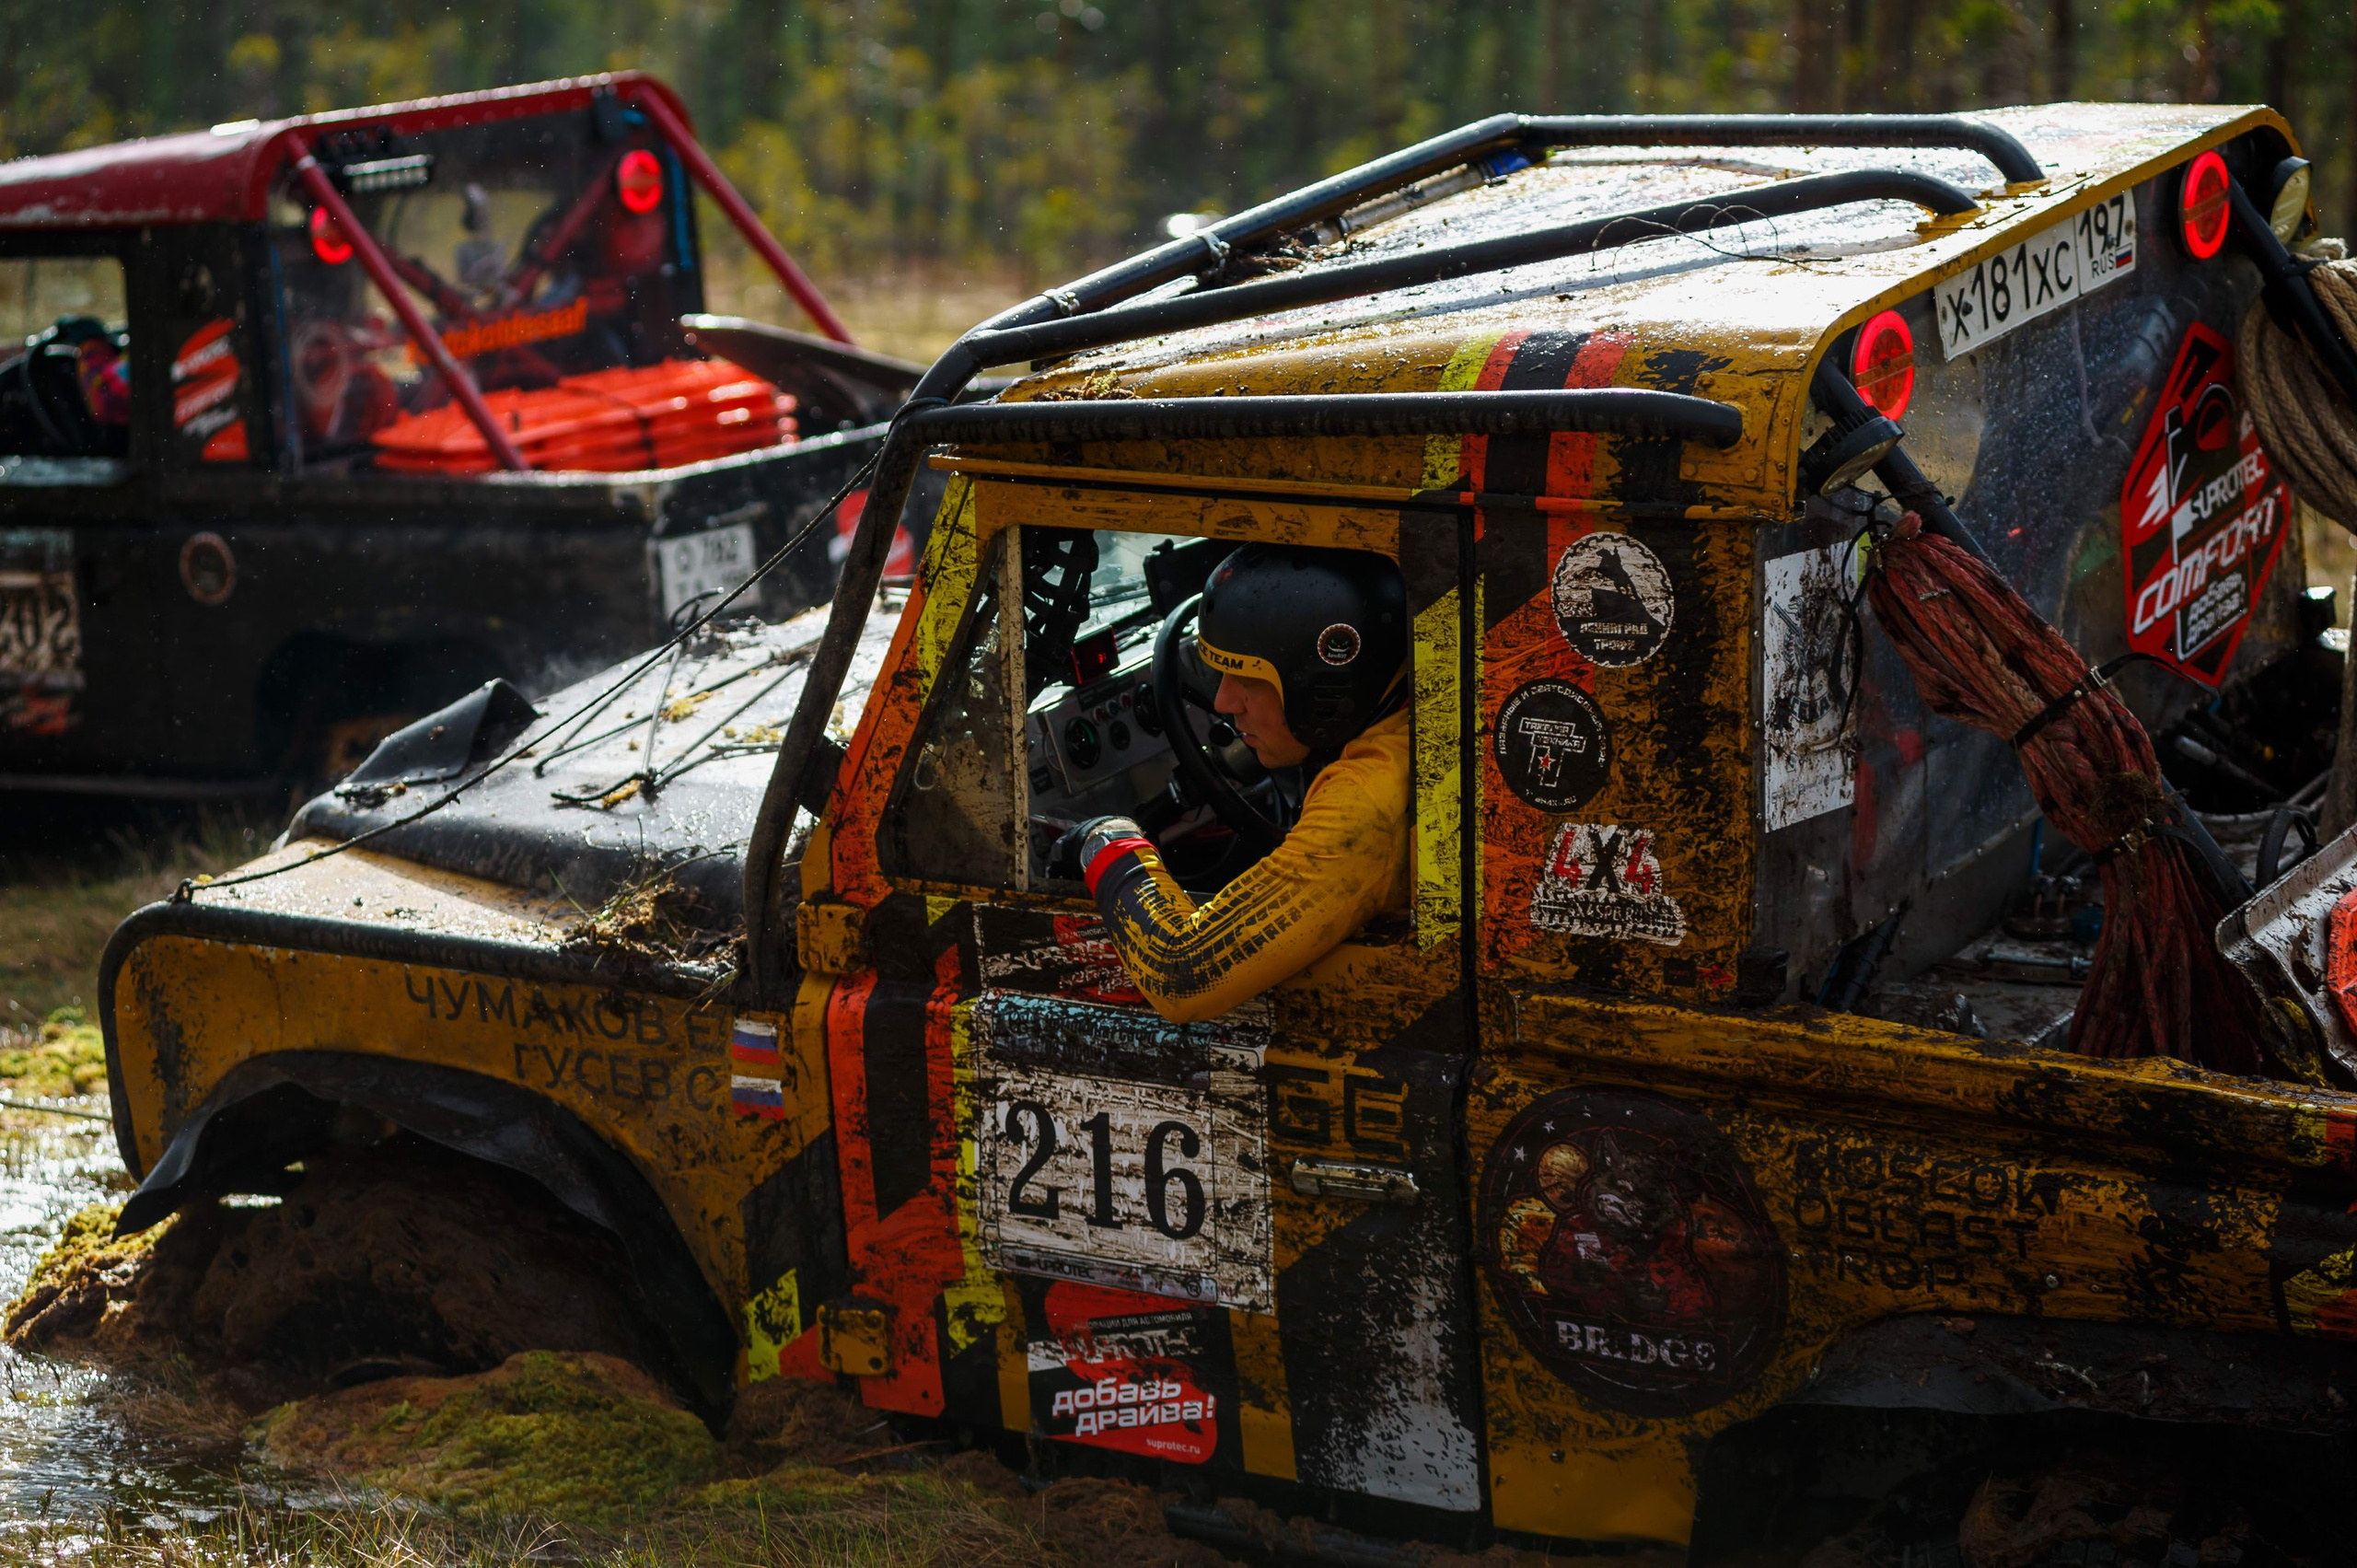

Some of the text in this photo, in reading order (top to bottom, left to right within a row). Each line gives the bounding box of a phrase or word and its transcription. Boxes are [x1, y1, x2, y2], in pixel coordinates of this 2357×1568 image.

[2080, 193, 2125, 260] 197
[2091, 255, 2115, 279] RUS
[1209, 650, 1244, 669] TEAM
[405, 970, 668, 1046] ЧУМАКОВ
[513, 1042, 672, 1103] ГУСЕВ
[1004, 1101, 1206, 1240] 216
[1794, 1194, 2038, 1259] OBLAST
[1121, 1316, 1140, 1329] ДЛЯ
[1051, 1377, 1182, 1417] добавь
[1075, 1393, 1215, 1437] драйва!
[1145, 1437, 1202, 1455] suprotec.ru
